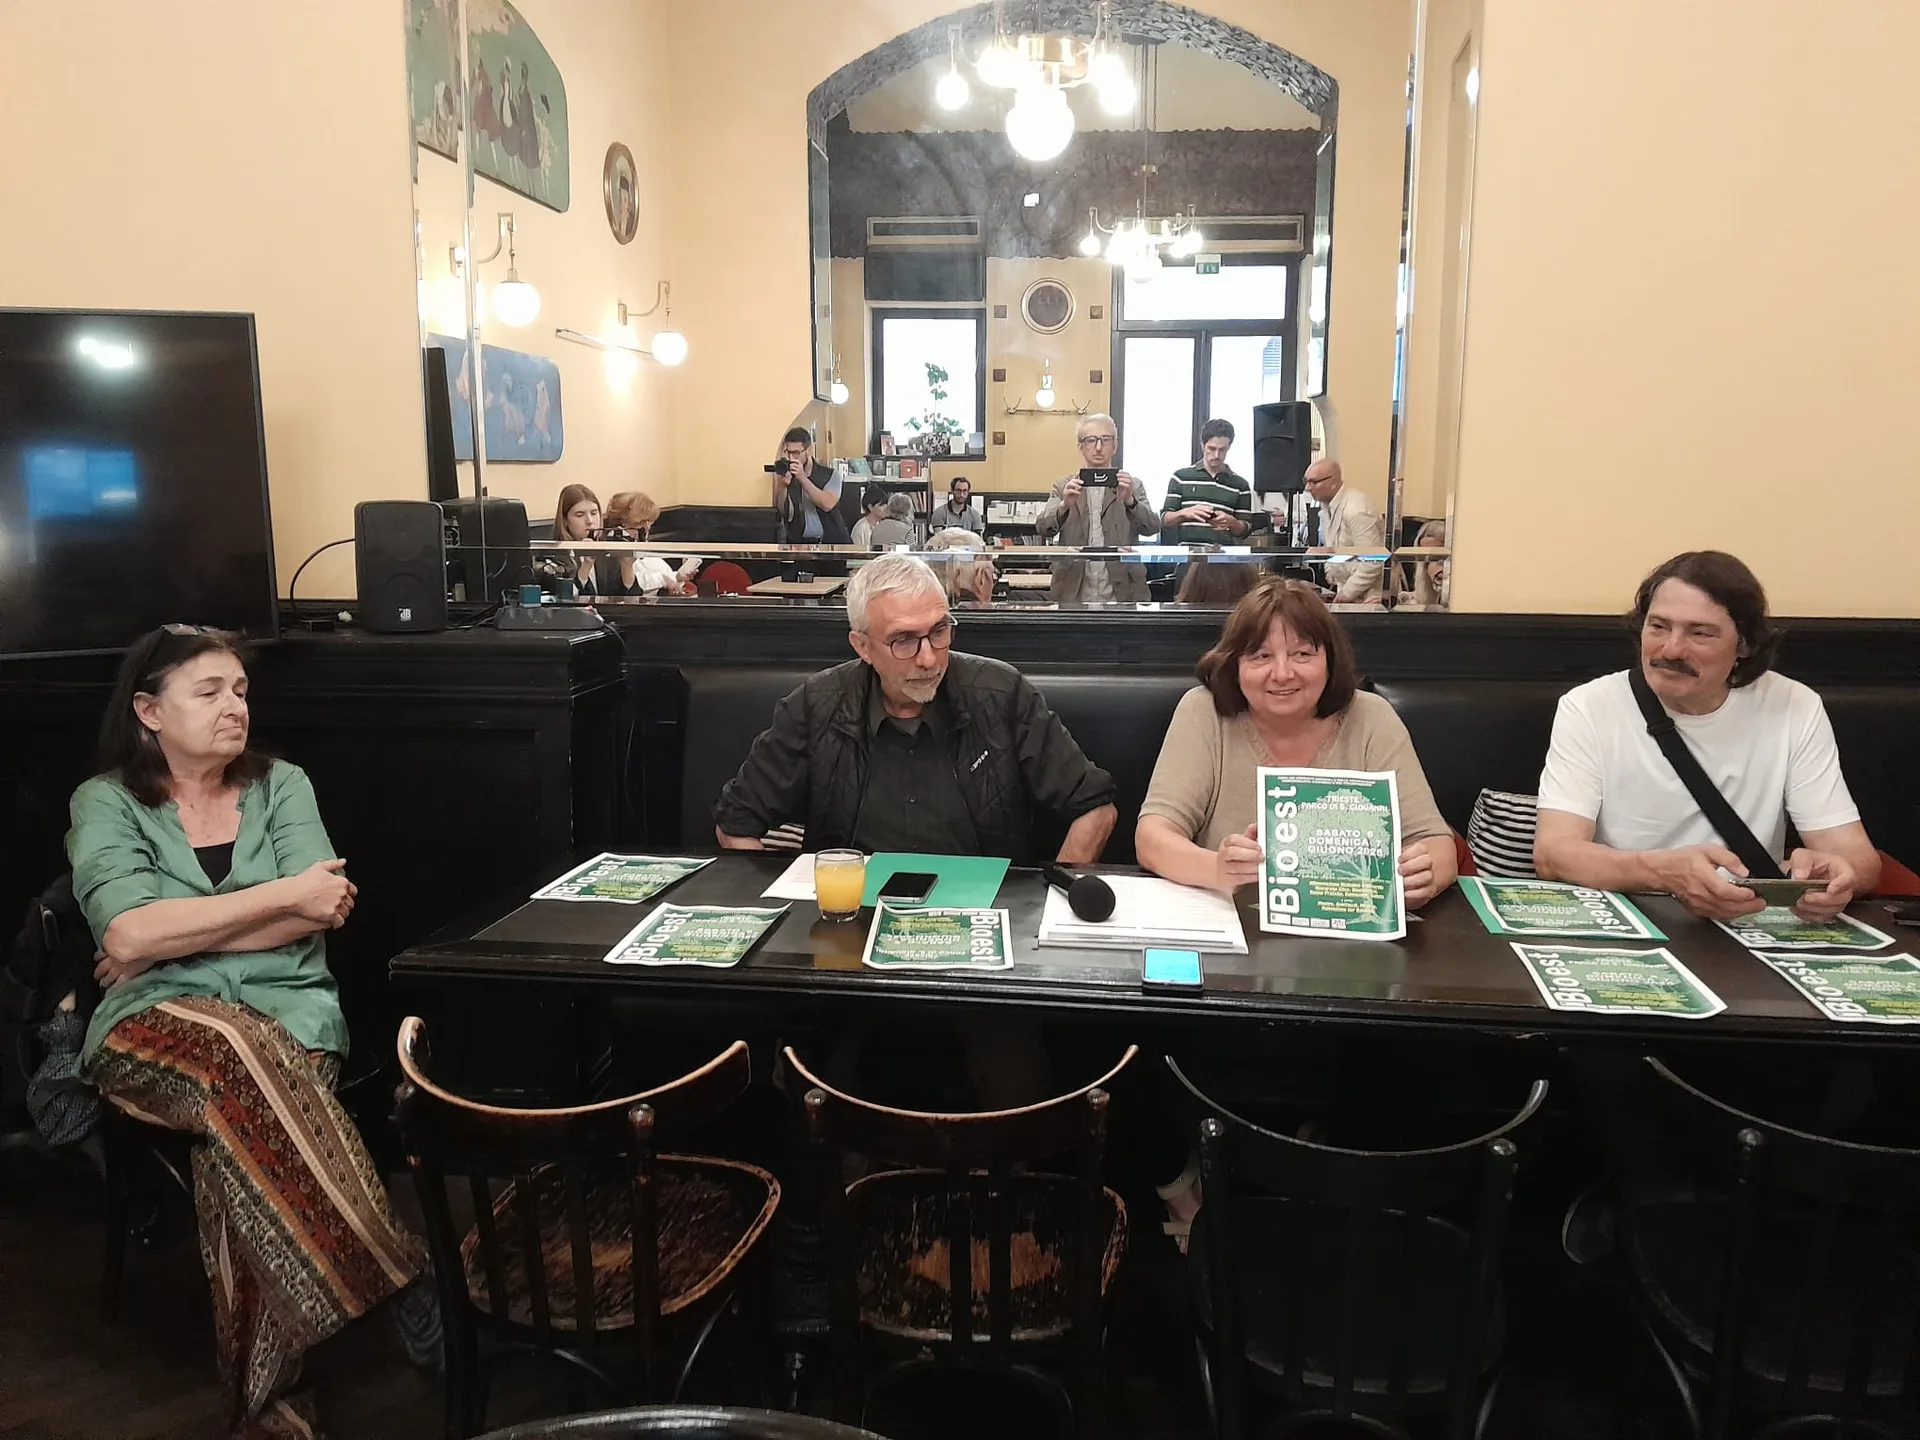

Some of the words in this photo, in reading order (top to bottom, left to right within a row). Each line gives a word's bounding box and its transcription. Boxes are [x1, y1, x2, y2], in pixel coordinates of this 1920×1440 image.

[1326, 795, 1360, 804] TRIESTE
[1301, 802, 1328, 810] PARCO
[1329, 803, 1338, 811] DI
[1316, 828, 1361, 837] SABATO
[1308, 836, 1369, 847] DOMENICA
[1308, 845, 1354, 855] GIUGNO
[1357, 846, 1383, 857] 2026
